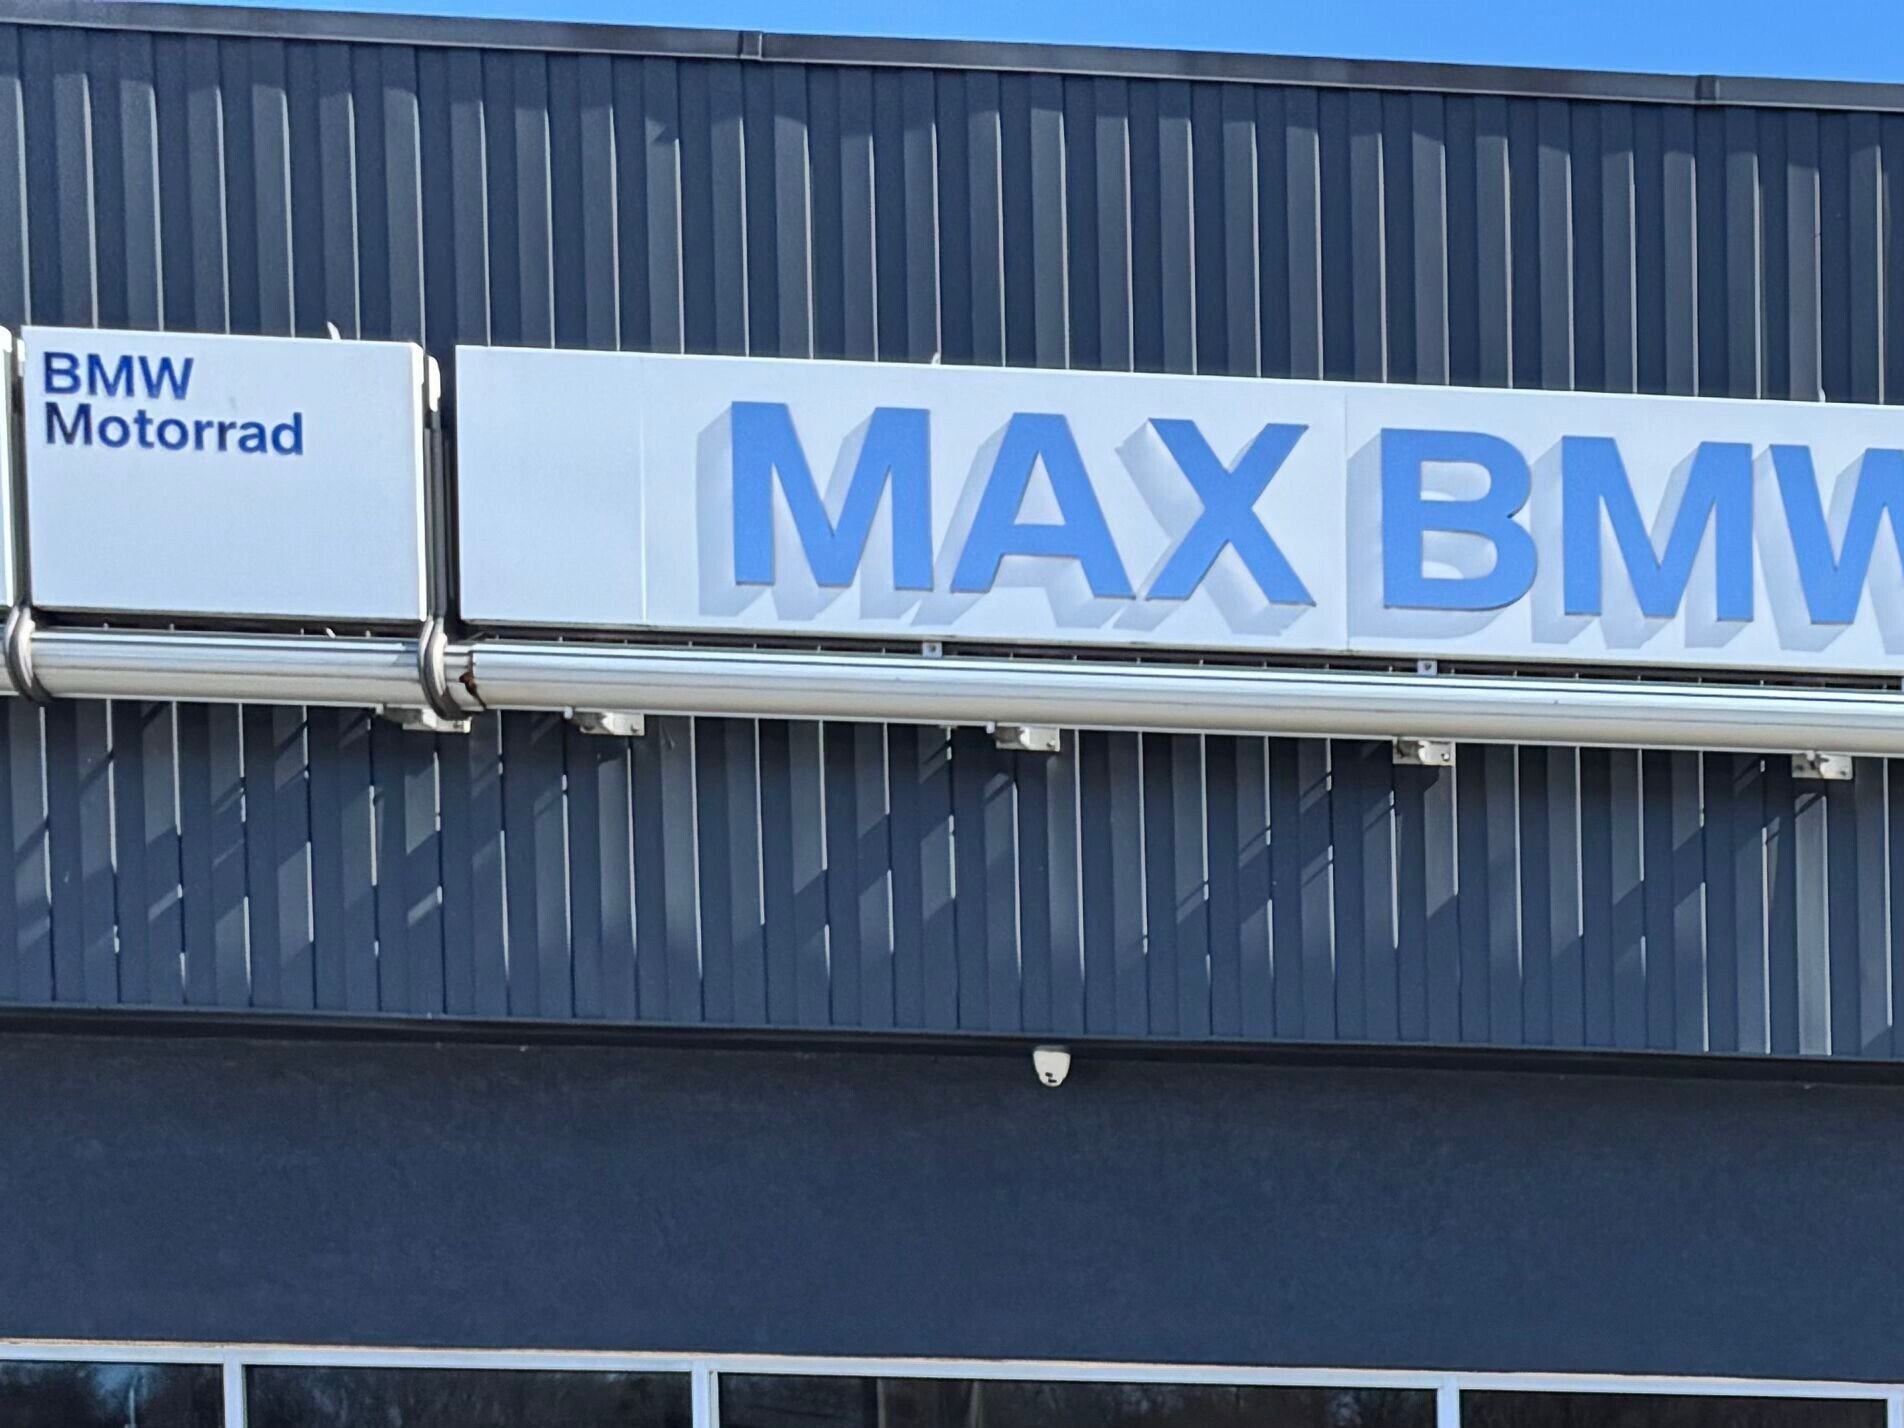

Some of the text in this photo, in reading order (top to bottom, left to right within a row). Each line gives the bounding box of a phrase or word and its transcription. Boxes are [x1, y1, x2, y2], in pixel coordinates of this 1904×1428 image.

[43, 351, 194, 401] BMW
[45, 401, 305, 455] Motorrad
[731, 402, 1309, 603] MAX
